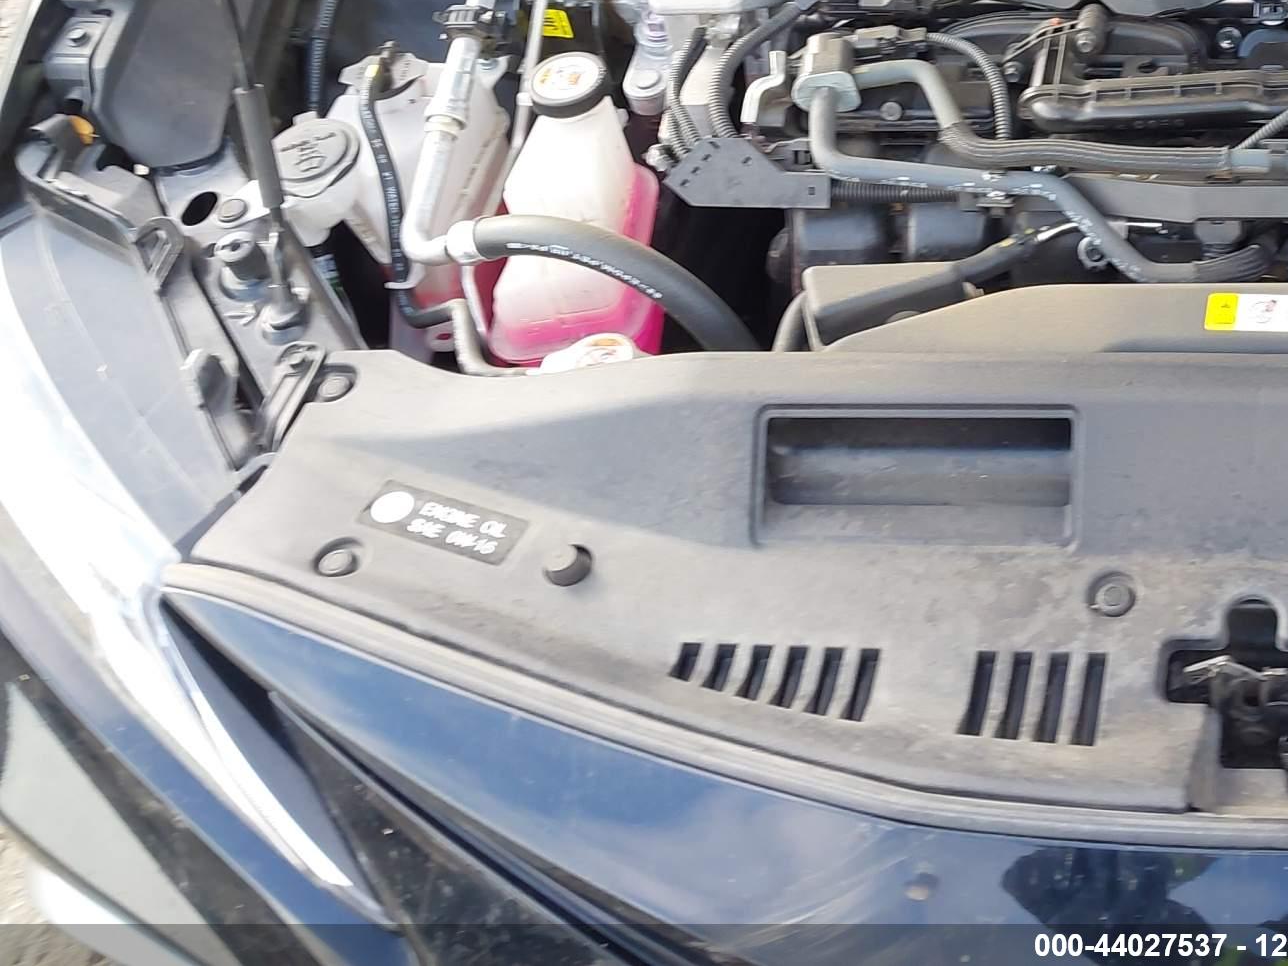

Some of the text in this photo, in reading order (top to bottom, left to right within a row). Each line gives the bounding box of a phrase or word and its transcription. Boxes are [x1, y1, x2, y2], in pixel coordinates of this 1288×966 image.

[407, 518, 446, 538] SAE
[419, 501, 507, 538] ENGINE OIL
